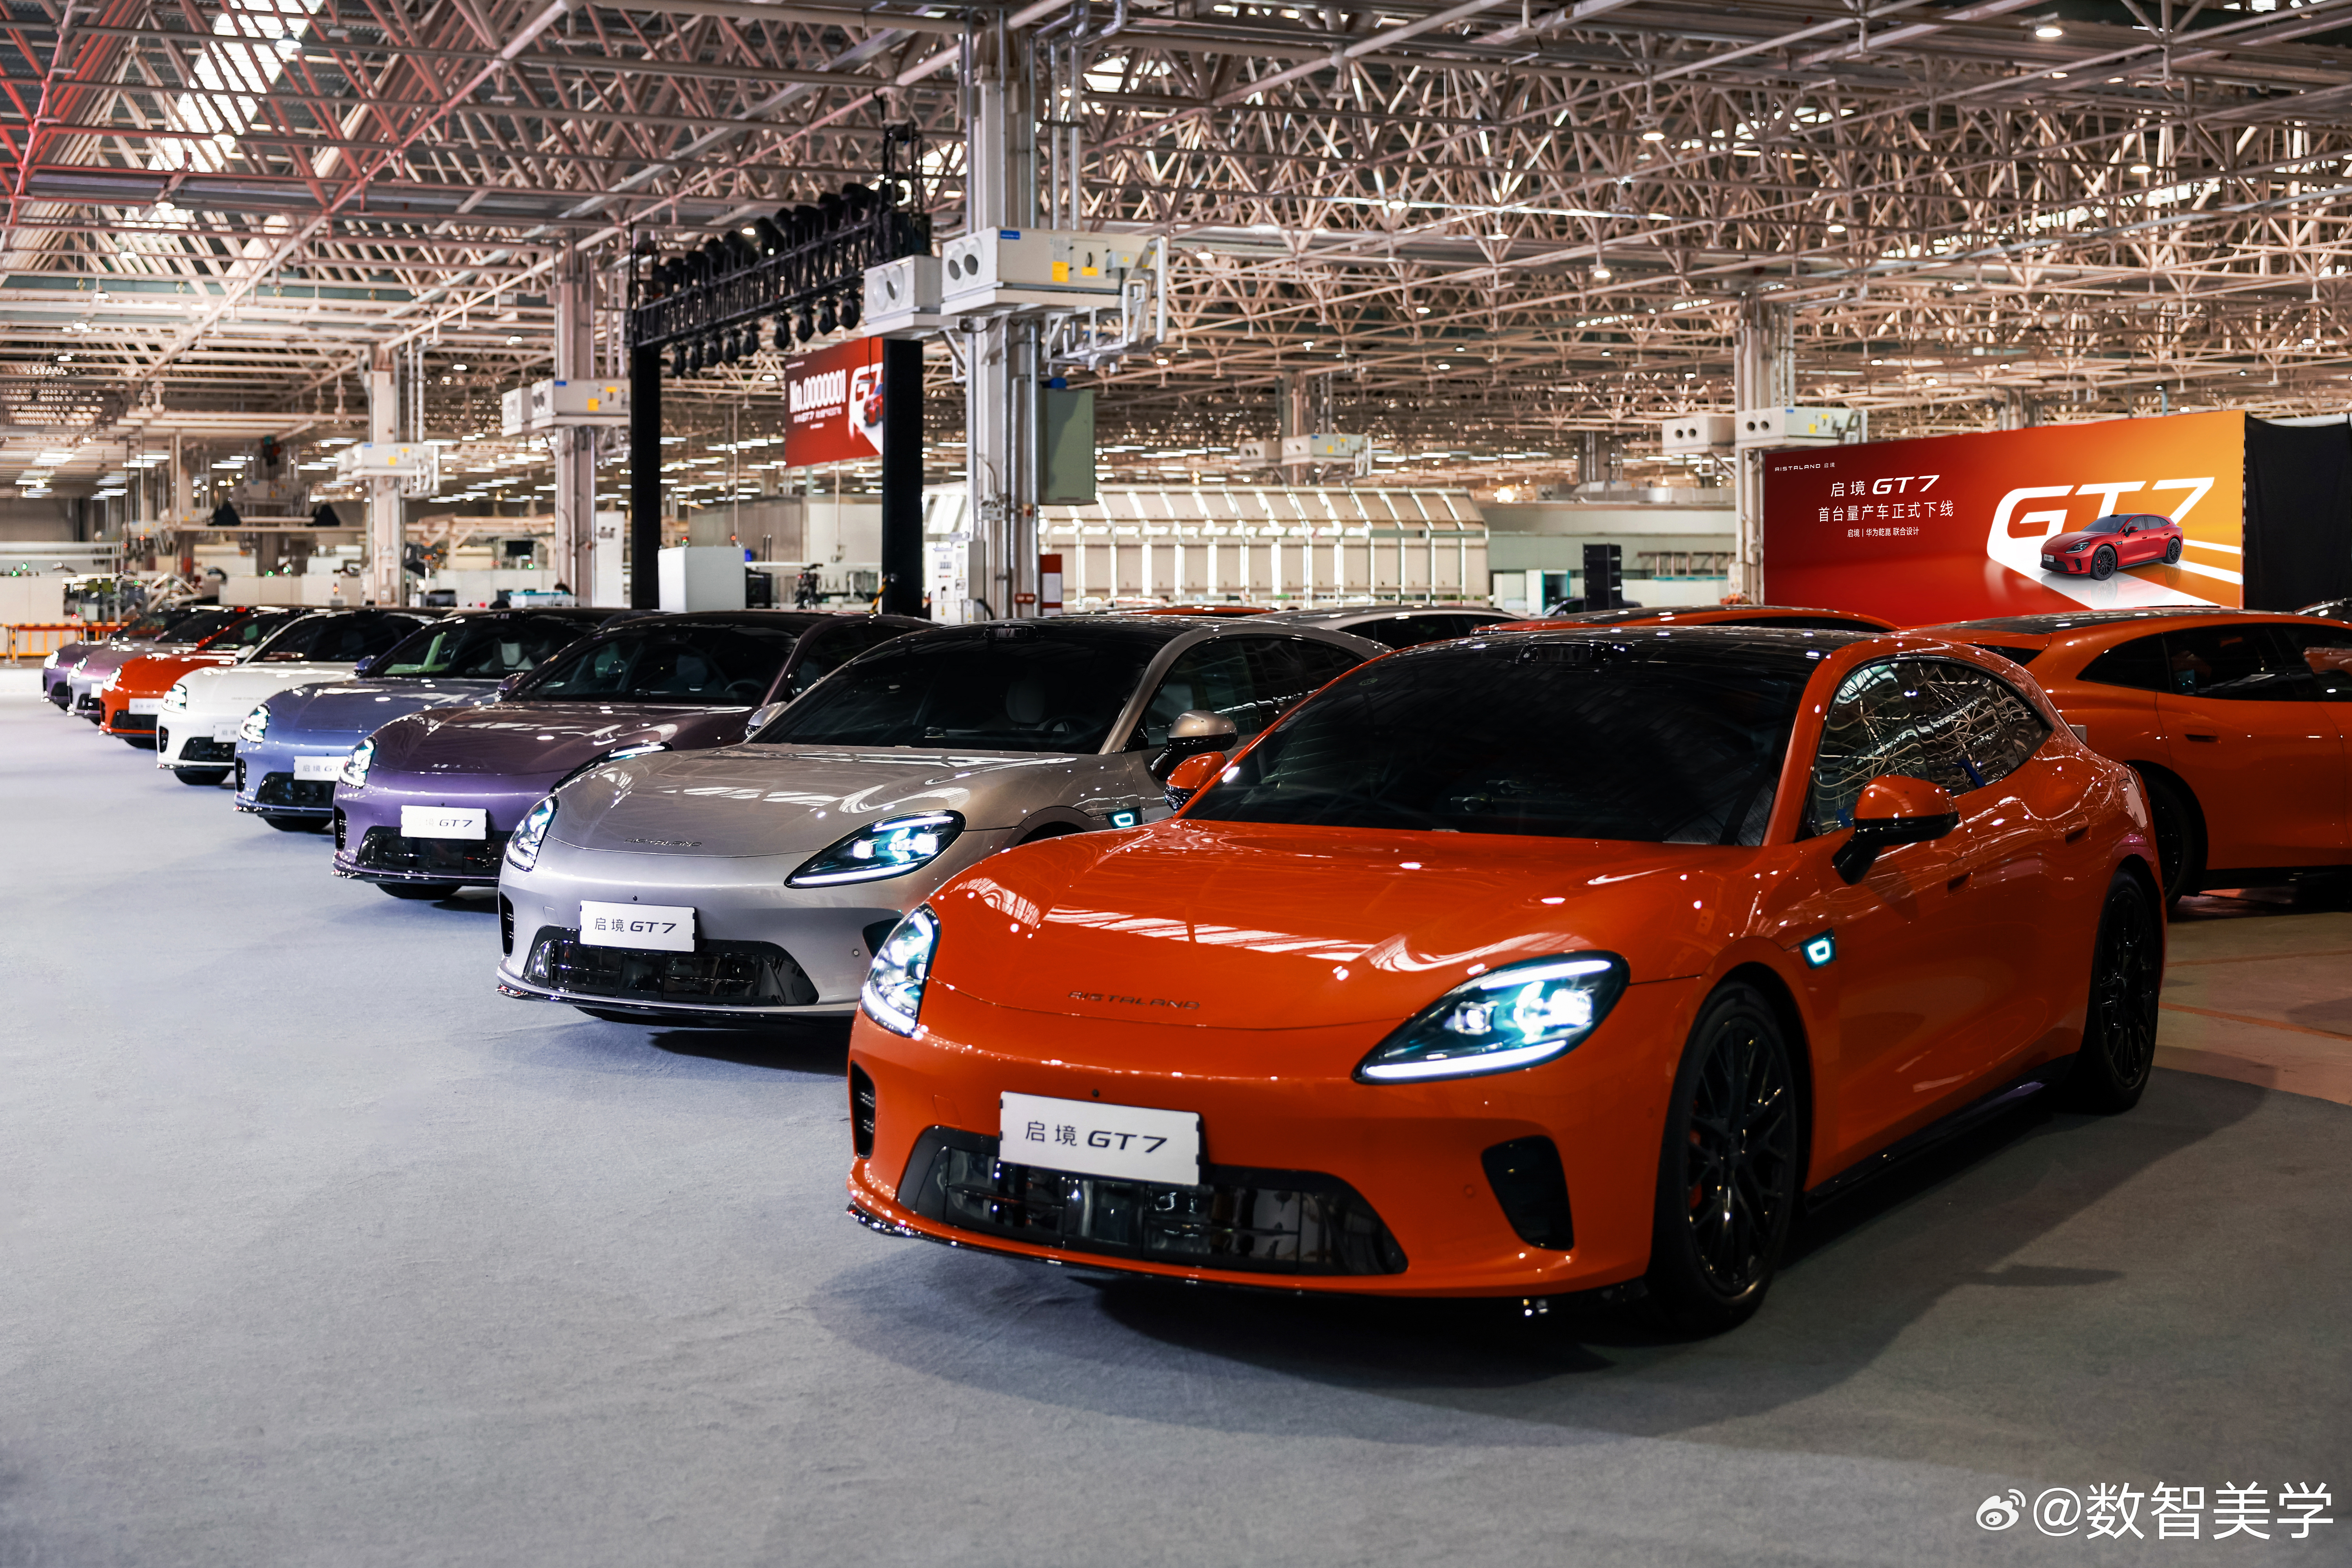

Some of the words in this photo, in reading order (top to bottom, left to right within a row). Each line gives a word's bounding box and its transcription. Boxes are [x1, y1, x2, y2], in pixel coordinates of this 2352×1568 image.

[1830, 480, 1866, 497] 启境
[1818, 500, 1954, 522] 首台量产车正式下线
[1847, 528, 1860, 537] 启境
[1893, 526, 1920, 536] 联合设计
[595, 917, 624, 932] 启境
[1025, 1120, 1078, 1147] 启境
